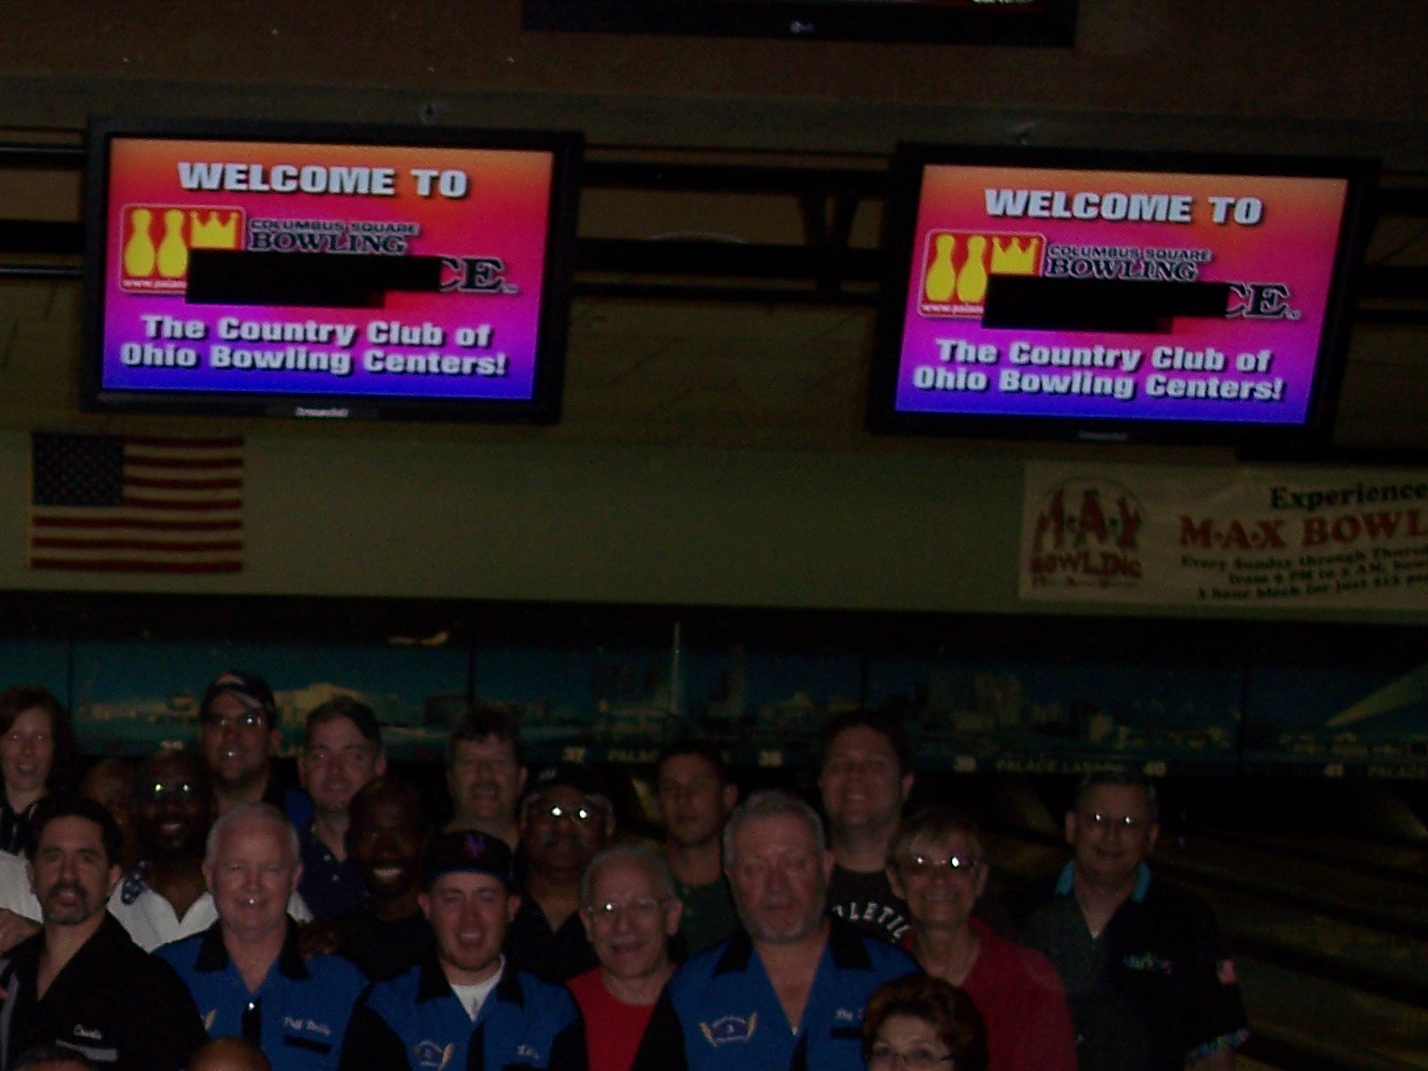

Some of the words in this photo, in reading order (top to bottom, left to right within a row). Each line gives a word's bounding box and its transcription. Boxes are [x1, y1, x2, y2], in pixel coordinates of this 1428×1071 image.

[178, 162, 396, 196] WELCOME
[410, 168, 469, 198] TO
[984, 188, 1193, 224] WELCOME
[1208, 196, 1264, 225] TO
[250, 219, 343, 232] COLUMBUS
[350, 222, 419, 235] SQUARE
[252, 231, 406, 253] BOWLING
[1048, 259, 1197, 281] BOWLING
[1143, 249, 1212, 262] SQUARE
[140, 315, 206, 339] The
[218, 316, 356, 346] Country
[366, 321, 442, 347] Club
[455, 324, 492, 348] of
[120, 343, 198, 367] Ohio
[210, 345, 351, 376] Bowling
[362, 350, 506, 376] Centers!
[934, 338, 998, 364] The
[1009, 340, 1142, 371] Country
[1151, 345, 1225, 372] Club
[1236, 348, 1273, 373] of
[912, 366, 988, 391] Ohio
[998, 368, 1135, 400] Bowling
[1145, 374, 1284, 401] Centers!
[1270, 482, 1428, 511] Experience
[1030, 551, 1141, 578] BOWLING
